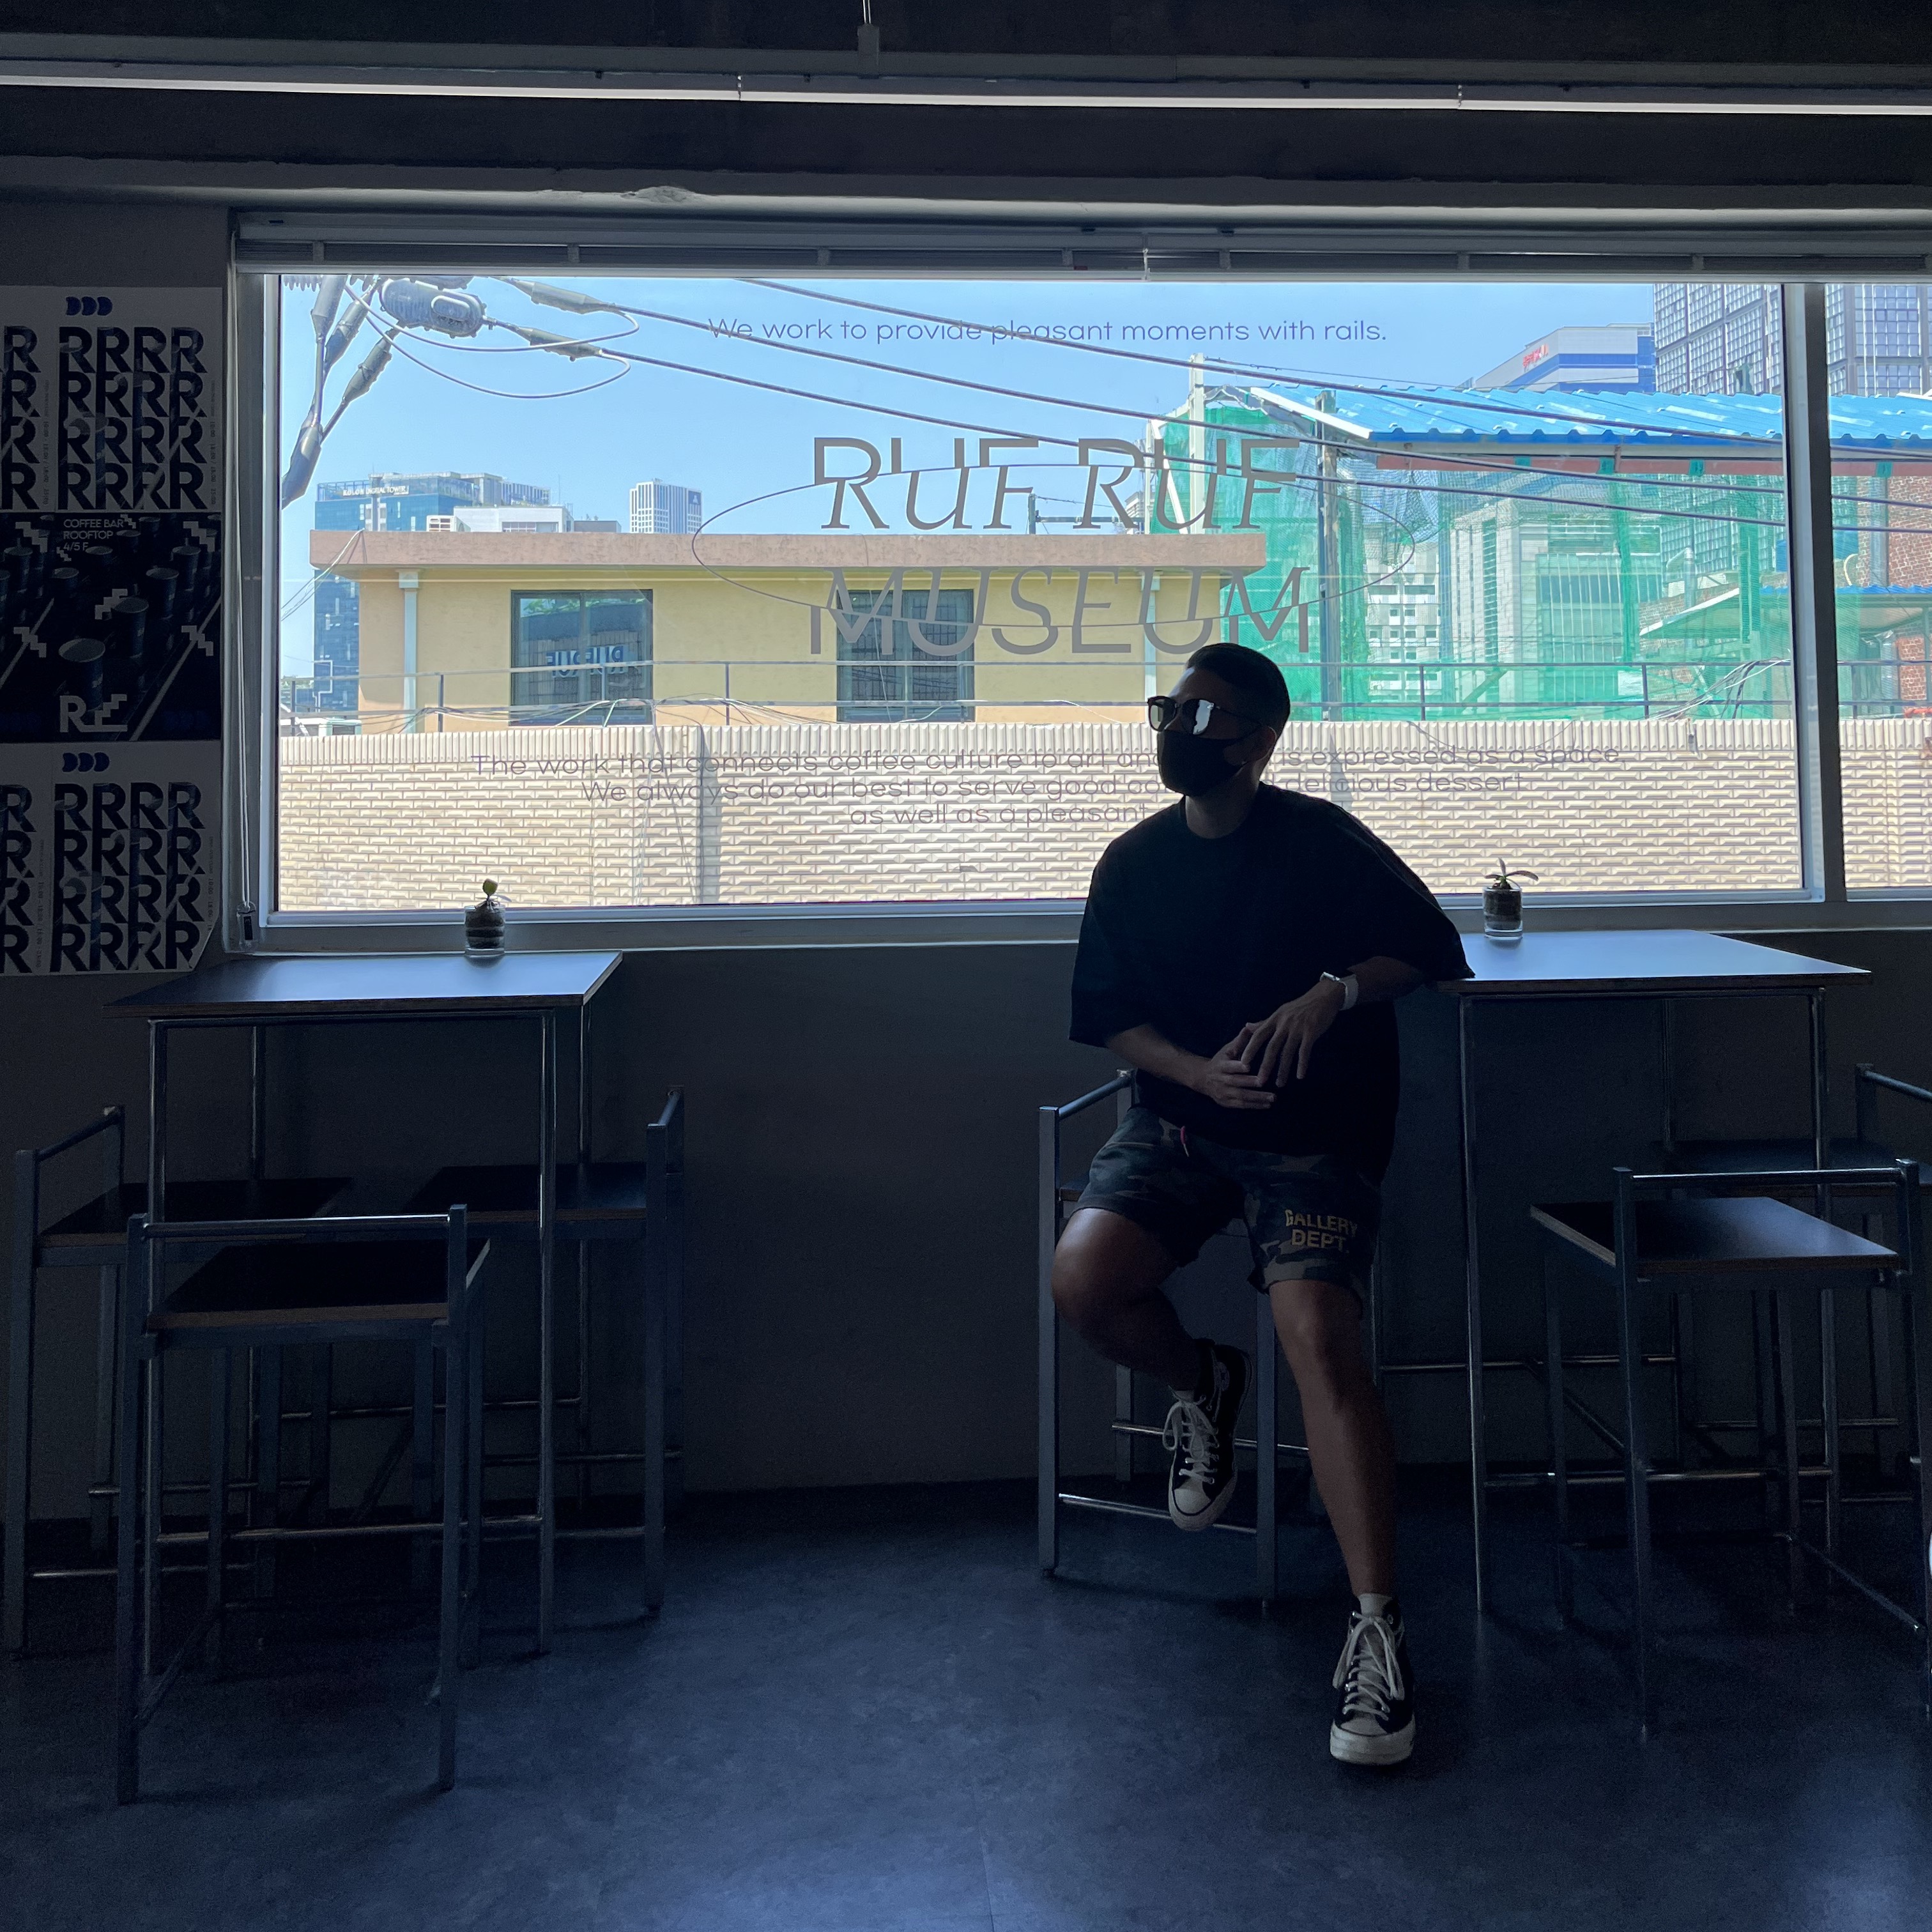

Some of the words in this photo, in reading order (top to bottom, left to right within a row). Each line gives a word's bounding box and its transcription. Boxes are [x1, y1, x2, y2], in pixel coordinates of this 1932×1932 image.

[709, 318, 753, 340] We
[762, 318, 832, 340] work
[840, 321, 867, 340] to
[877, 319, 981, 344] provide
[992, 320, 1112, 345] pleasant
[1123, 321, 1249, 341] moments
[1259, 321, 1314, 341] with
[1324, 320, 1386, 341] rails.
[815, 437, 1039, 530] RUF
[1073, 438, 1300, 530] RUF
[63, 530, 114, 540] ROOFTOP
[64, 519, 102, 528] COFFEE
[103, 519, 124, 528] BAR
[811, 567, 1310, 655] MUSEUM
[471, 755, 526, 775] The
[537, 753, 610, 774] work
[618, 754, 682, 774] that
[686, 753, 818, 772] connects
[828, 750, 916, 770] coffee
[926, 749, 1022, 769] culture
[1032, 751, 1057, 769] to
[1068, 751, 1106, 768] art
[1312, 744, 1455, 771] expressed
[1467, 750, 1498, 764] as
[1509, 749, 1524, 763] a
[1535, 748, 1620, 769] space
[581, 781, 627, 802] We
[637, 779, 738, 805] always
[748, 779, 784, 799] do
[795, 783, 843, 799] our
[852, 777, 914, 798] best
[924, 778, 949, 797] to
[959, 780, 1036, 797] serve
[1047, 774, 1117, 801] good
[1286, 771, 1407, 793] delicious
[1416, 771, 1523, 792] dessert
[851, 809, 884, 825] as
[894, 803, 946, 824] well
[956, 808, 989, 824] as
[1000, 808, 1015, 824] a
[1027, 802, 1149, 828] pleasant
[1285, 1209, 1358, 1237] GALLERY
